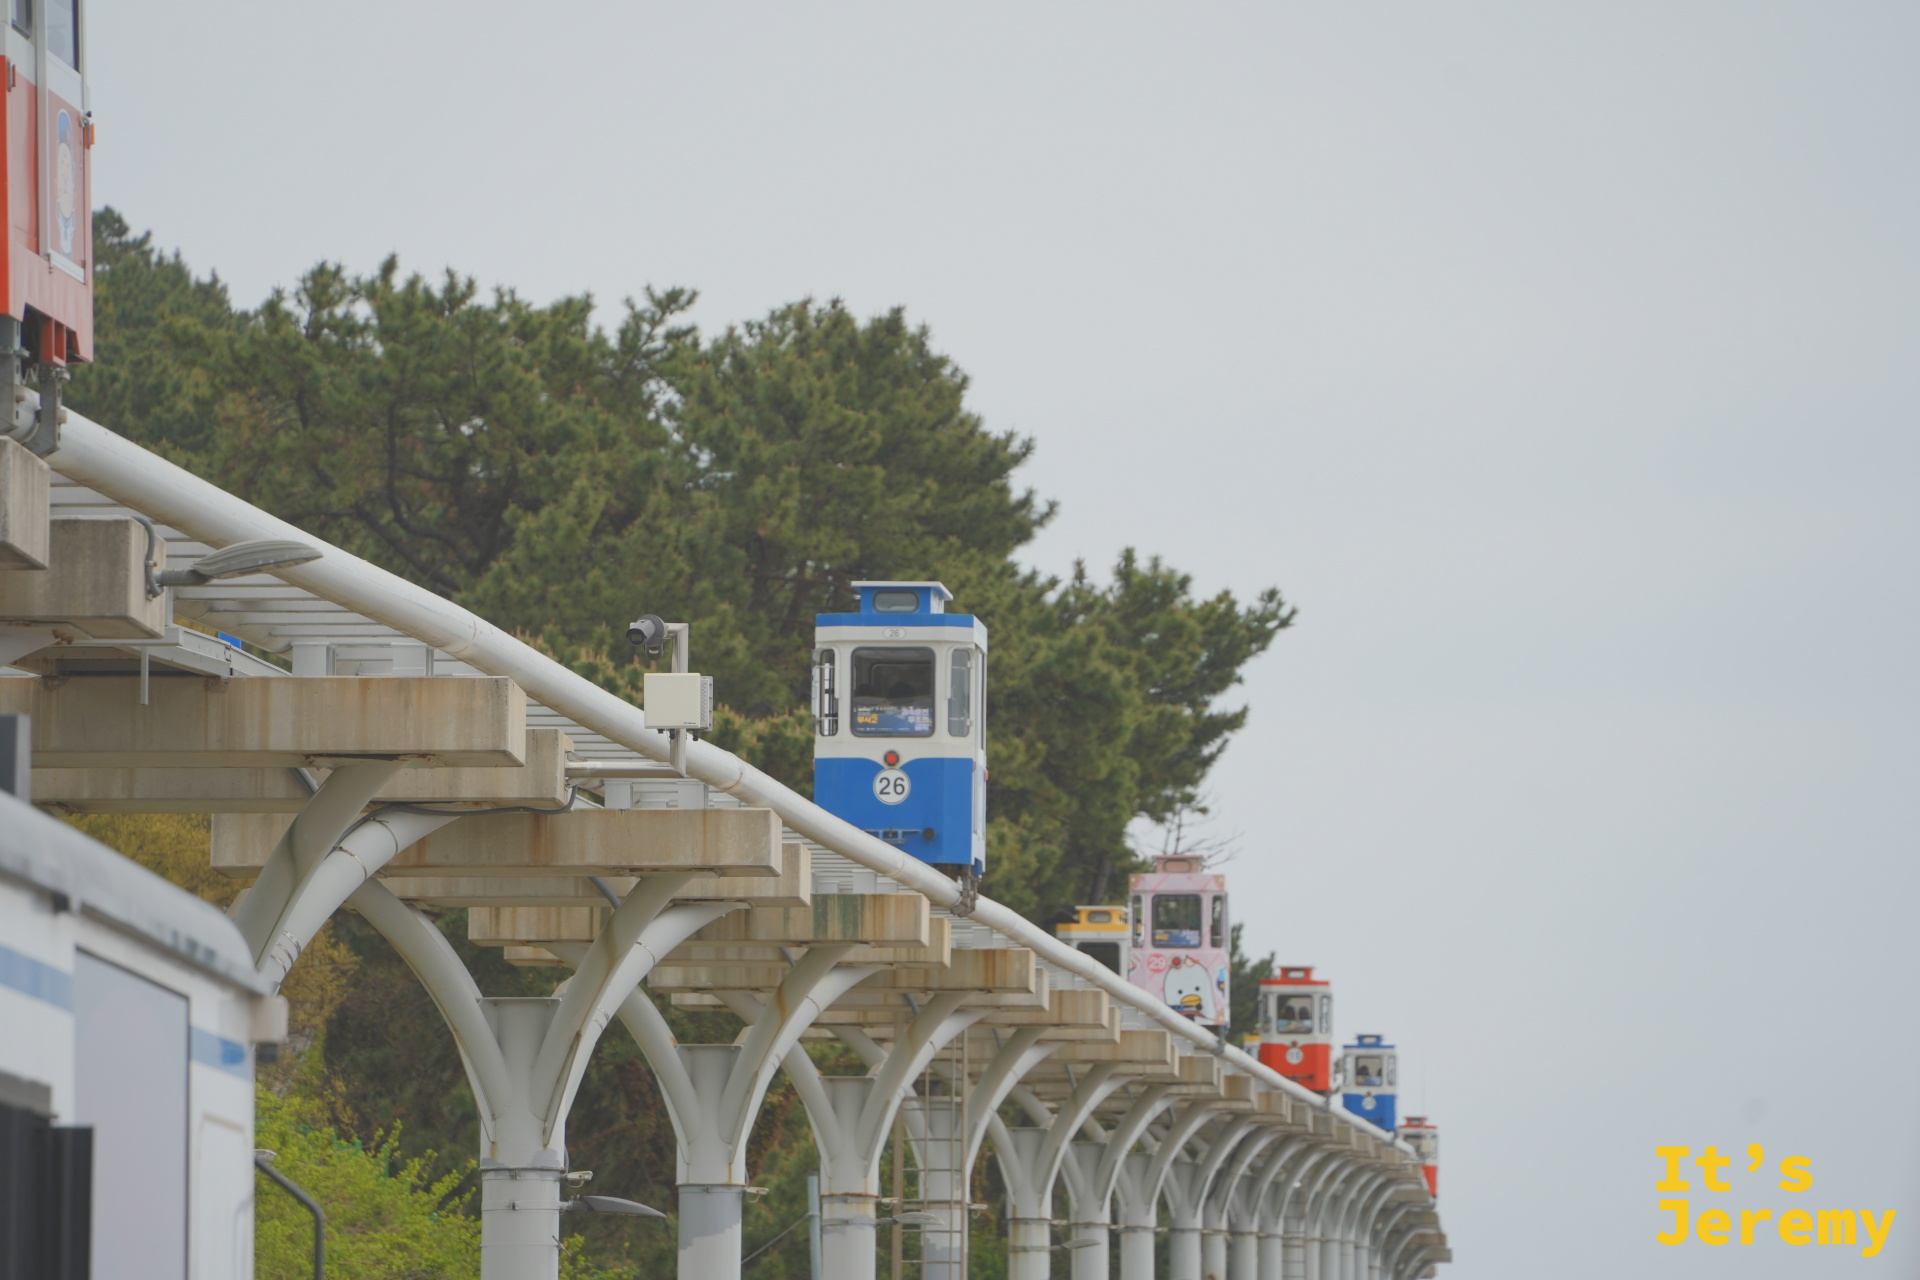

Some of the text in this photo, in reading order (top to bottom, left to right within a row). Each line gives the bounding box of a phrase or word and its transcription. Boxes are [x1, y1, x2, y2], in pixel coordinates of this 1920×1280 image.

[889, 628, 900, 638] 26
[878, 777, 905, 796] 26
[1149, 956, 1166, 970] 29
